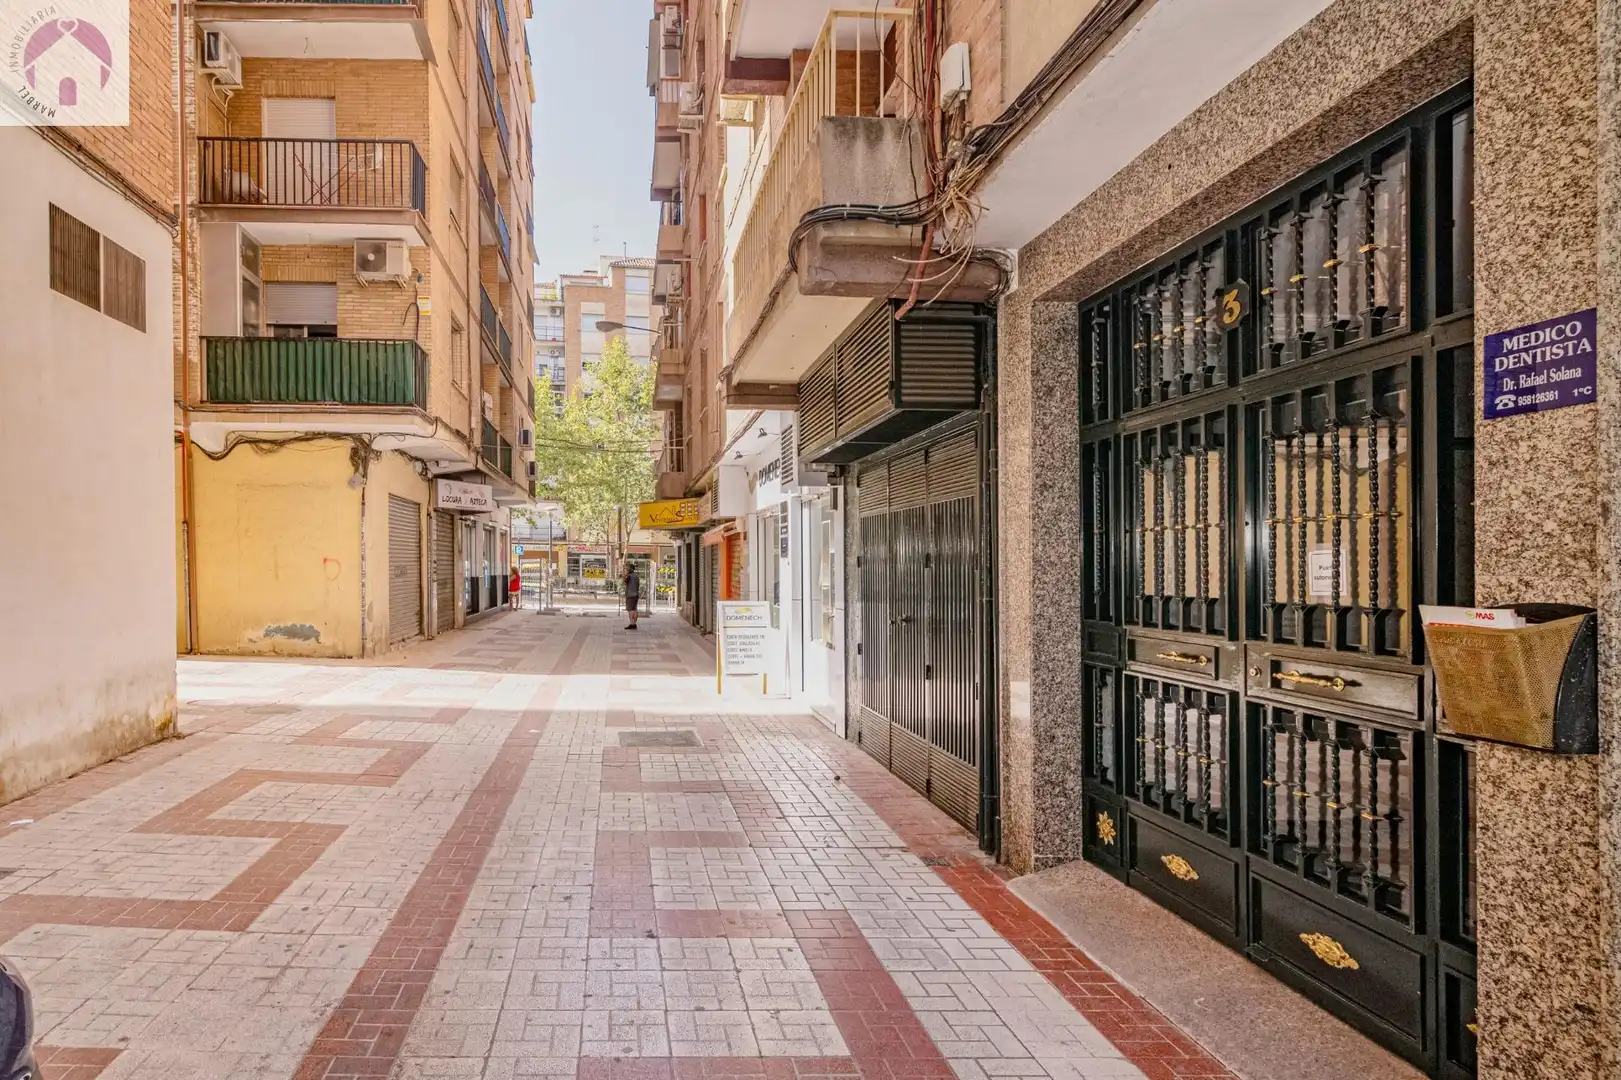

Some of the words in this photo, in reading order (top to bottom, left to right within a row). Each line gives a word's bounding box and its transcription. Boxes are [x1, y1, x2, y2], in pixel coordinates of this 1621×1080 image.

[1222, 288, 1241, 324] 3
[1502, 321, 1582, 353] MEDICO
[1494, 337, 1592, 372] DENTISTA
[1503, 378, 1517, 392] Dr.
[1519, 369, 1547, 389] Rafael
[1550, 366, 1582, 383] Solana
[1475, 612, 1495, 620] MAS
